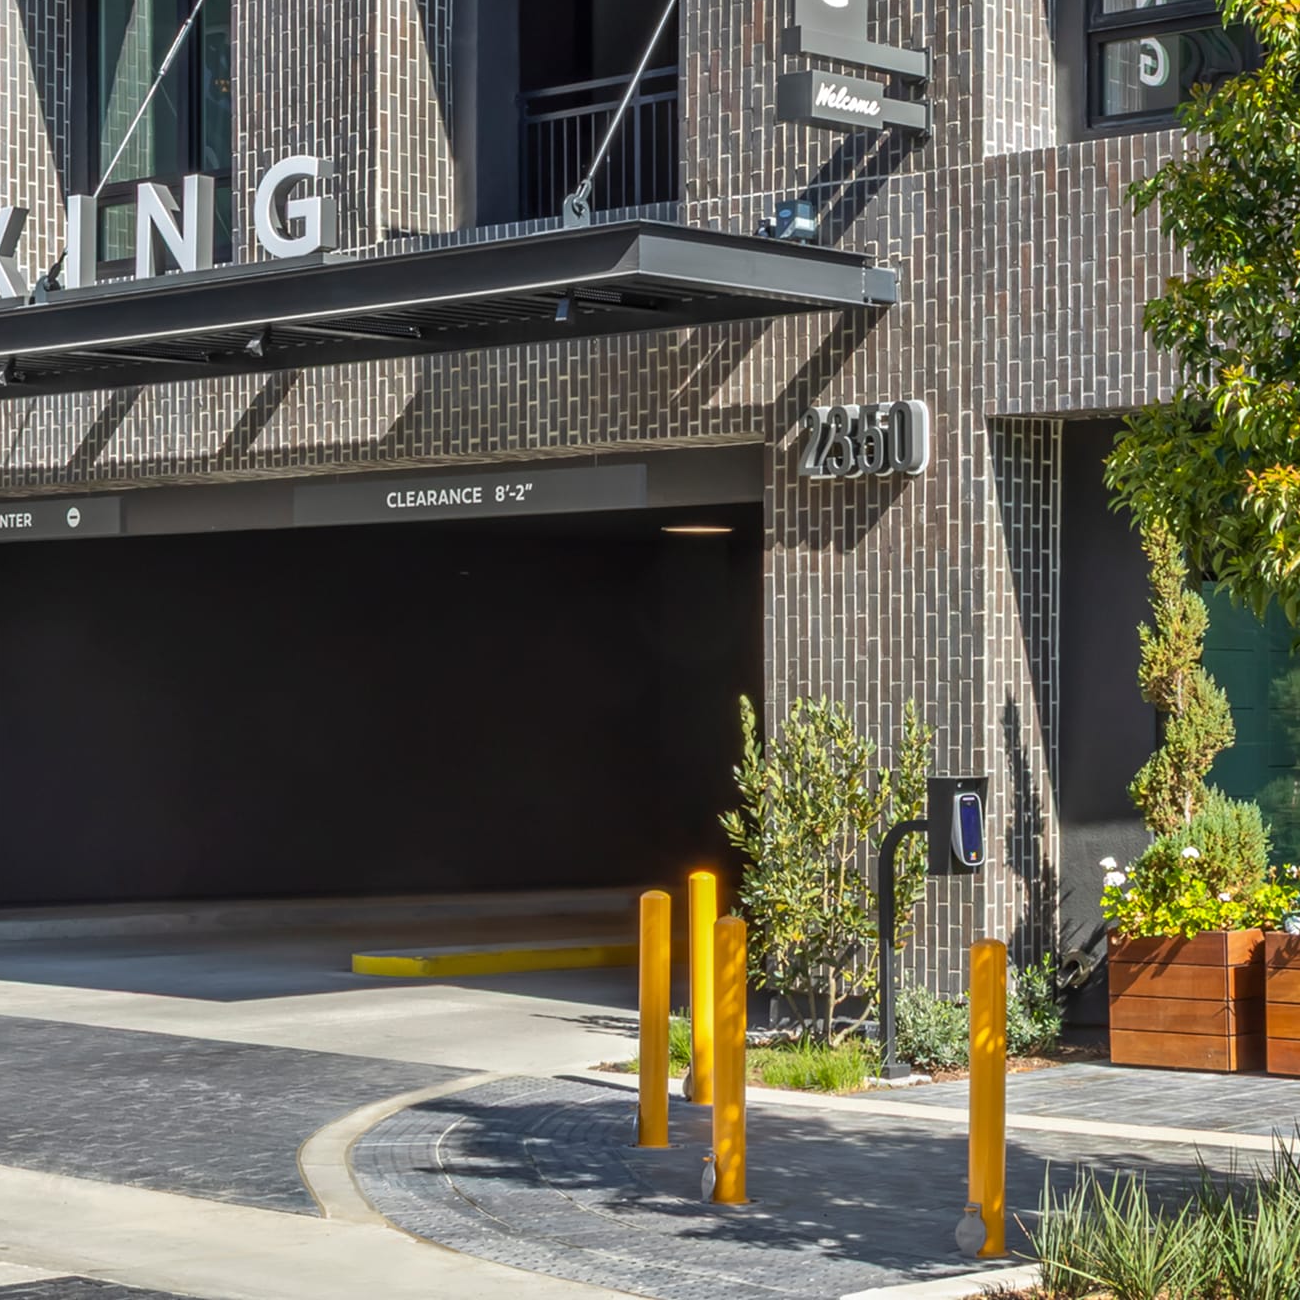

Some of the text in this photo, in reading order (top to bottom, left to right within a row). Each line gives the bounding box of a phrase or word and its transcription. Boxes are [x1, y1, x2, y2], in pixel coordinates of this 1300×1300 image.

[815, 82, 881, 116] Welcome
[798, 400, 930, 479] 2350
[386, 487, 483, 508] CLEARANCE
